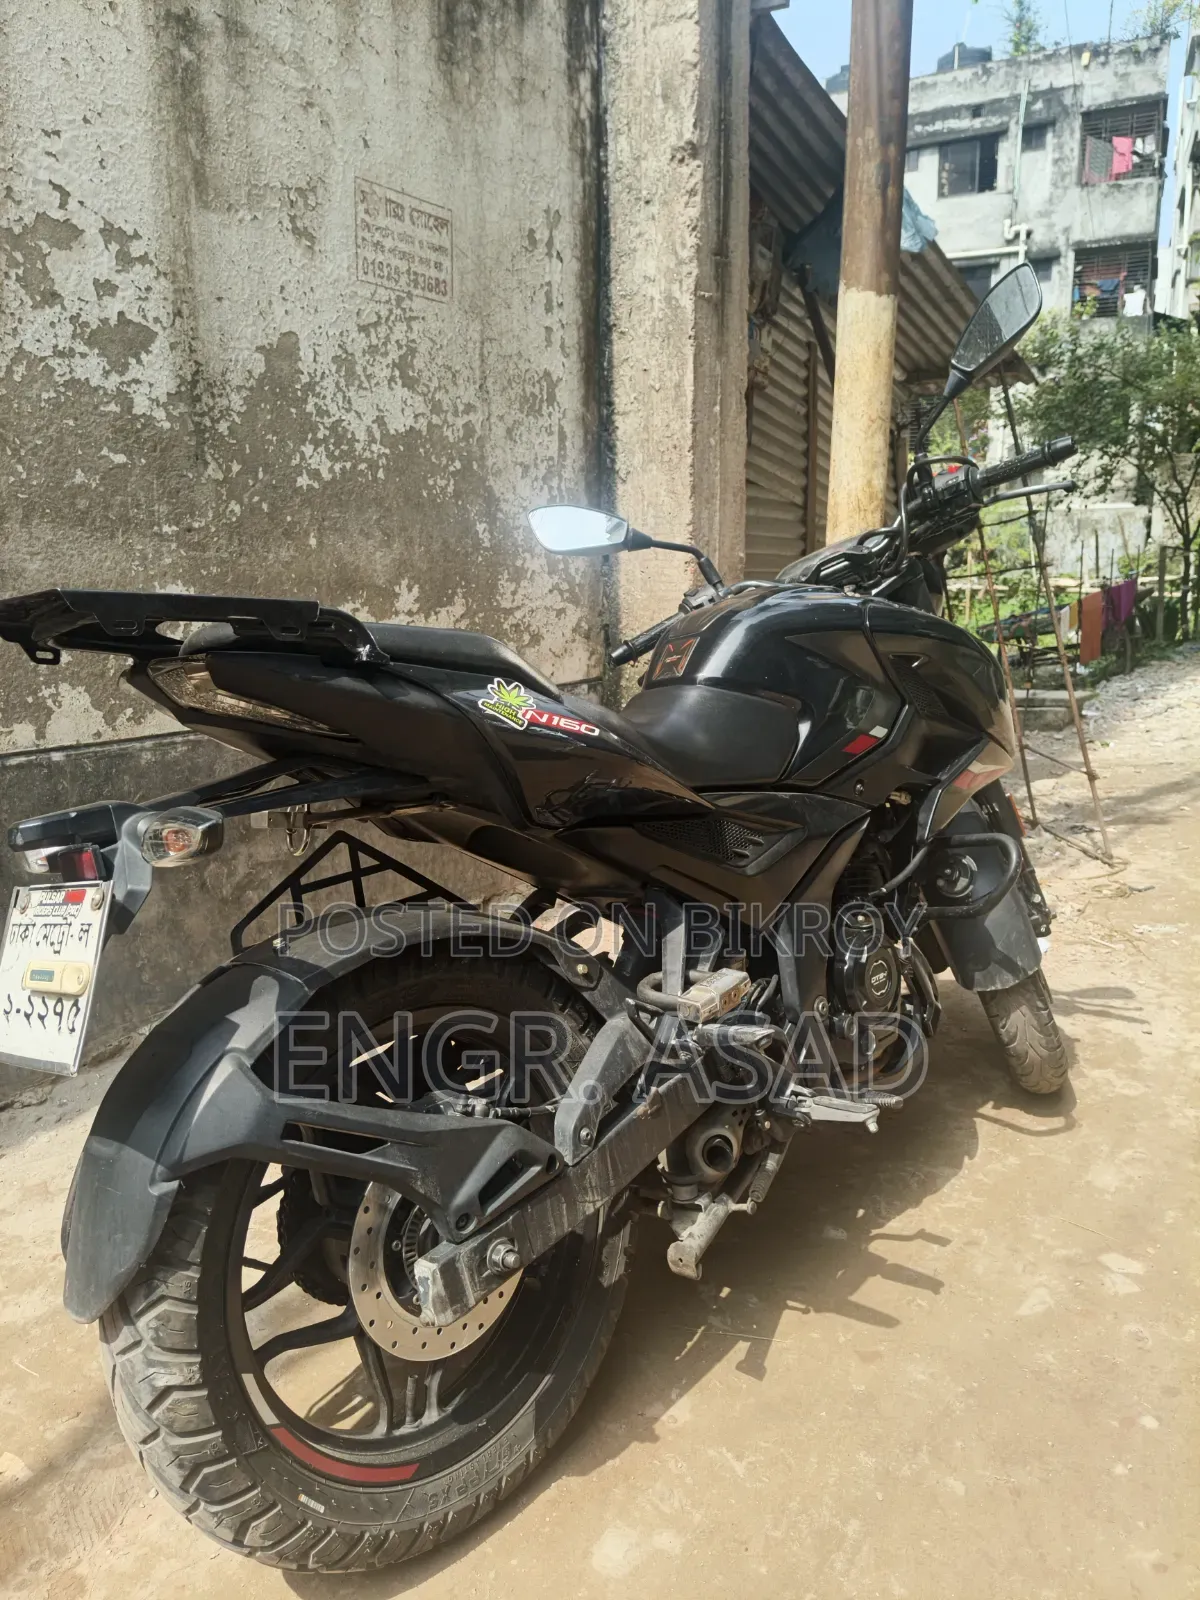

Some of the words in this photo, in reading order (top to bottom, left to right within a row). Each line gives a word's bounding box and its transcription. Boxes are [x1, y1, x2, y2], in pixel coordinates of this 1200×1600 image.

[483, 702, 524, 725] MAINTENANCE
[495, 702, 517, 716] HIGH
[525, 709, 600, 736] N160
[39, 890, 66, 904] PULSAR
[10, 922, 36, 946] ঢাকা
